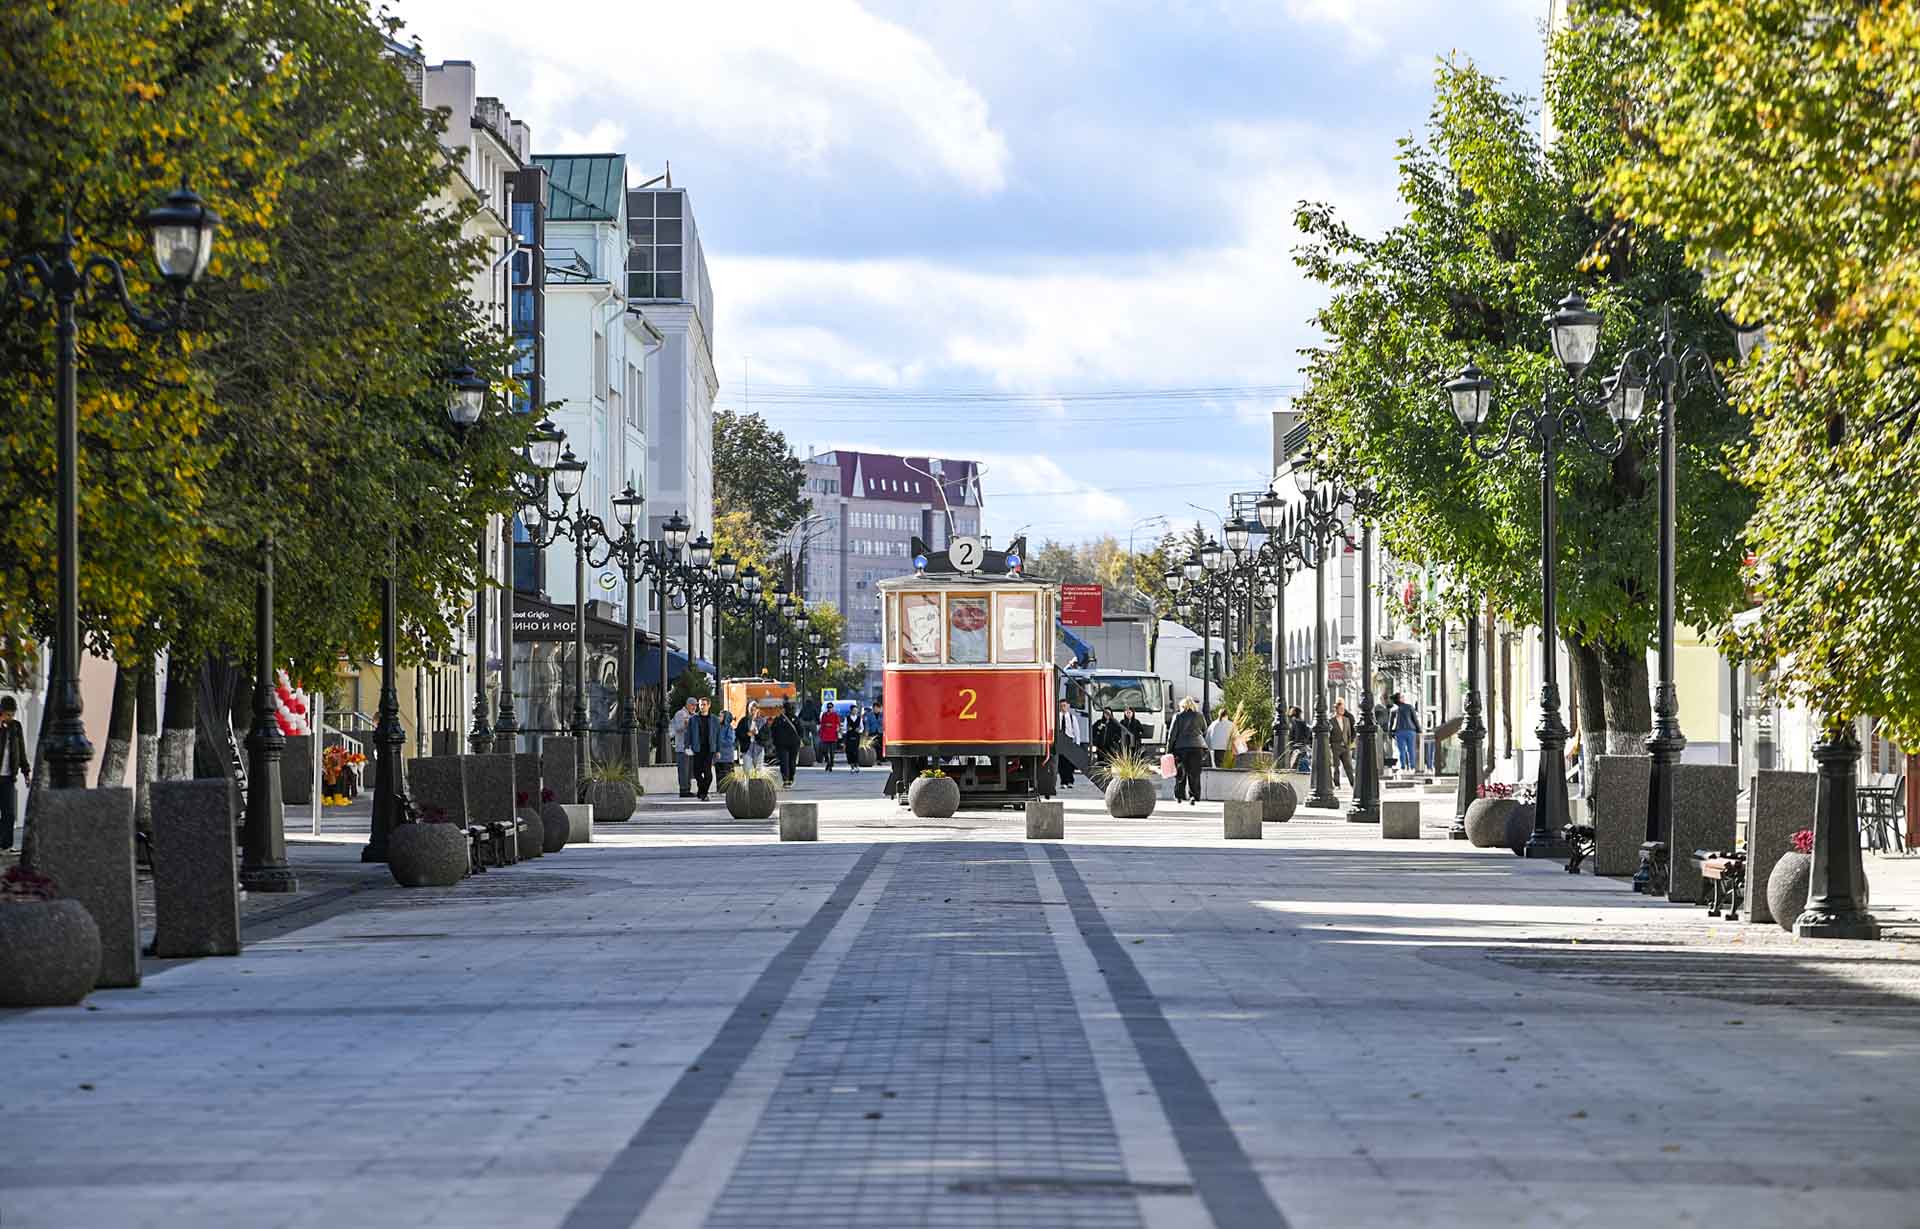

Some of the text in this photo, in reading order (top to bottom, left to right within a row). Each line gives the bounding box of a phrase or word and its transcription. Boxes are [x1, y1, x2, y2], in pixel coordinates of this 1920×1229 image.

[959, 543, 974, 565] 2
[527, 611, 550, 620] Grigio
[553, 622, 585, 633] мор
[958, 688, 978, 720] 2
